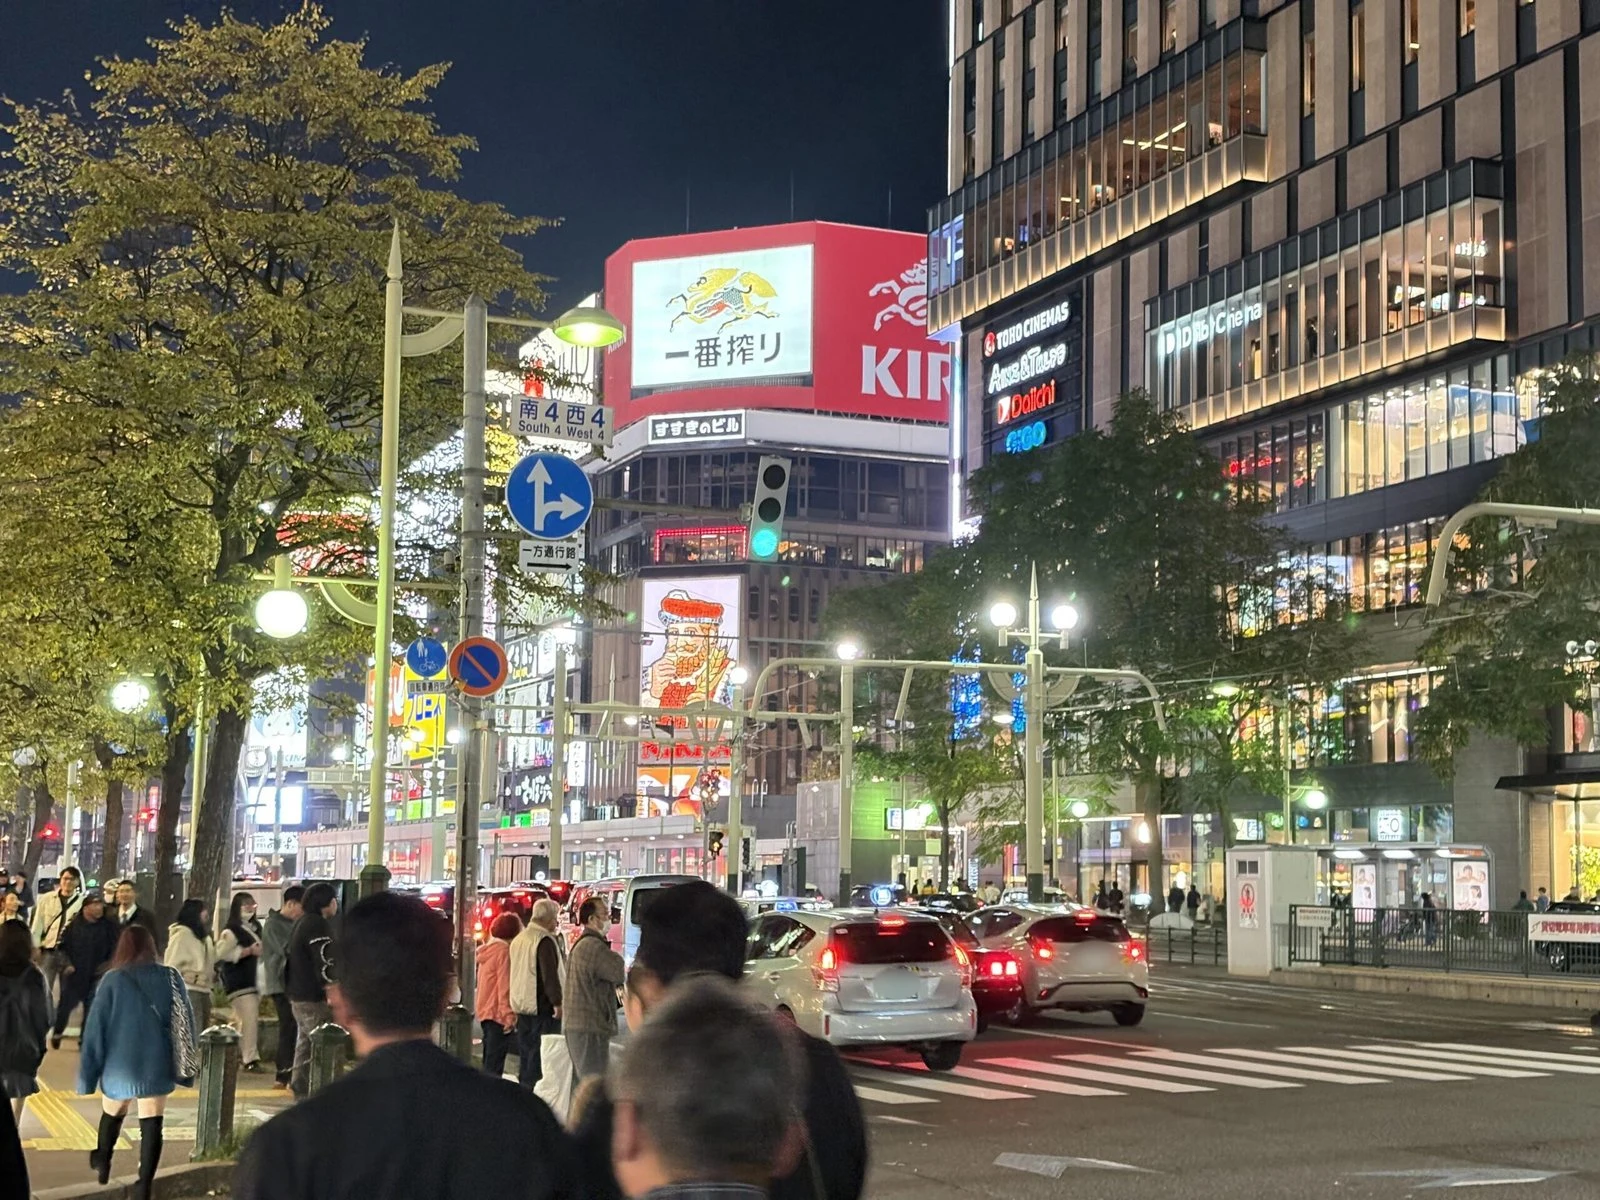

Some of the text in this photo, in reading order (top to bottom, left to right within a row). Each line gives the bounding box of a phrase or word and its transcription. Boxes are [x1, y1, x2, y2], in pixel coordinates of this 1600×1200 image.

[996, 301, 1070, 351] TOHO CINEMAS
[665, 332, 781, 368] 一番搾り
[1011, 378, 1056, 418] Daiichi
[519, 420, 605, 440] South 4 West 4
[655, 417, 739, 437] すすきのビル
[522, 545, 576, 559] 一方通行路
